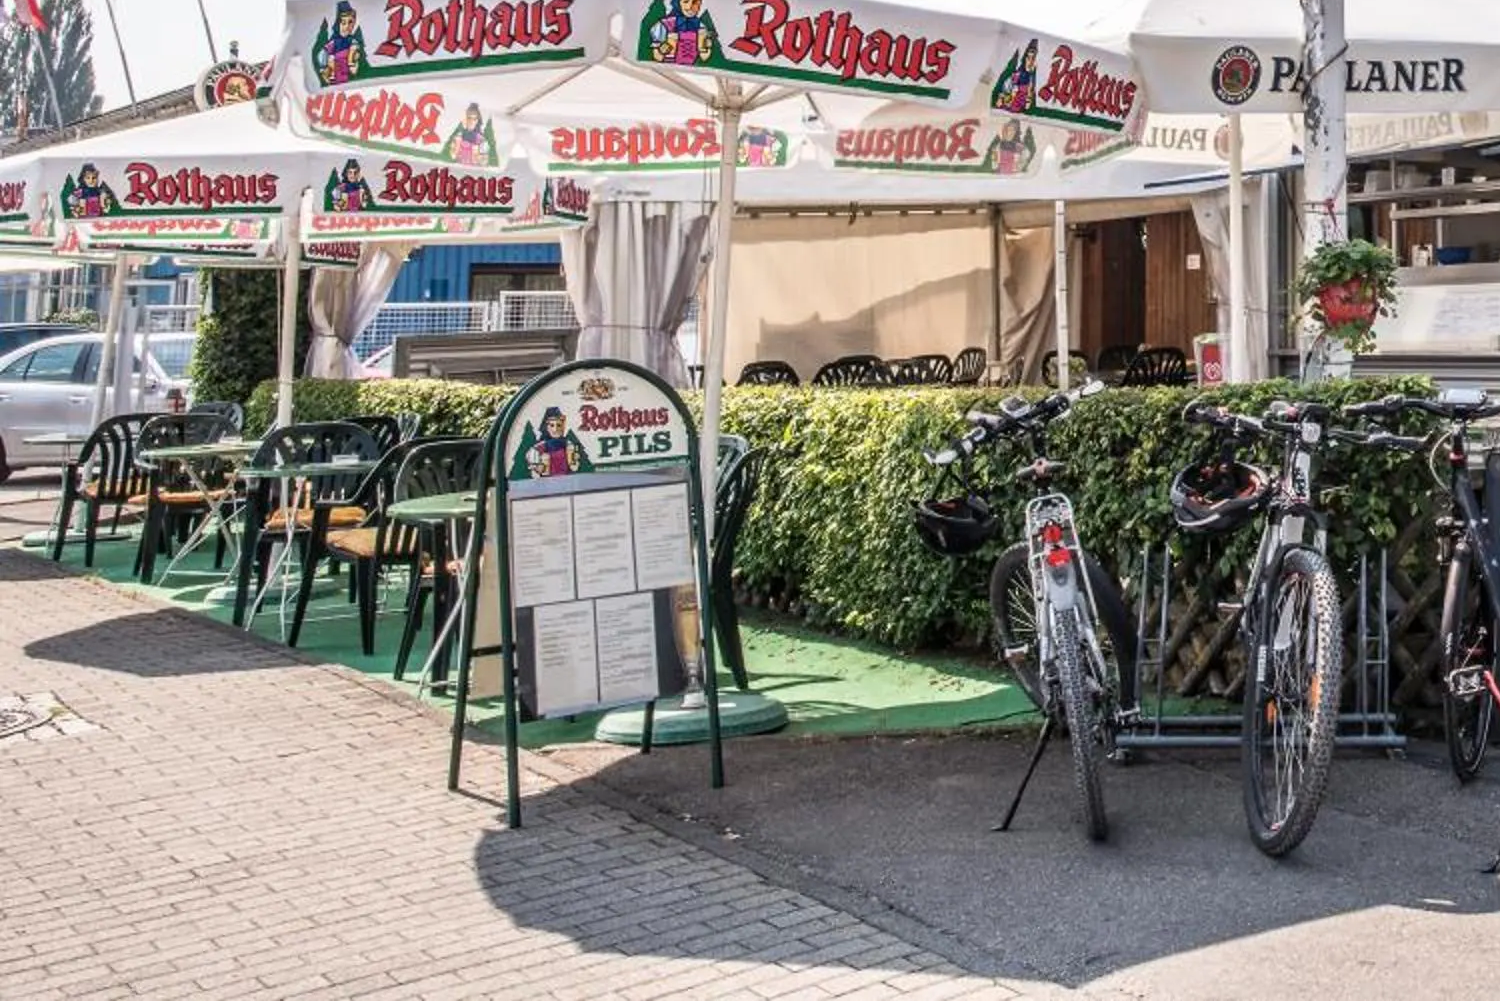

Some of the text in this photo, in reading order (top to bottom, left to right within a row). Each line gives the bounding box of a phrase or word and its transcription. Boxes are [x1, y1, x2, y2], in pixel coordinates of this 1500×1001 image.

[1038, 44, 1137, 120] Rothaus
[1269, 56, 1467, 93] PALANER
[124, 161, 280, 212] Rothaus
[378, 160, 515, 206] Rothaus
[578, 404, 669, 433] Rothaus
[598, 431, 672, 458] PILS
